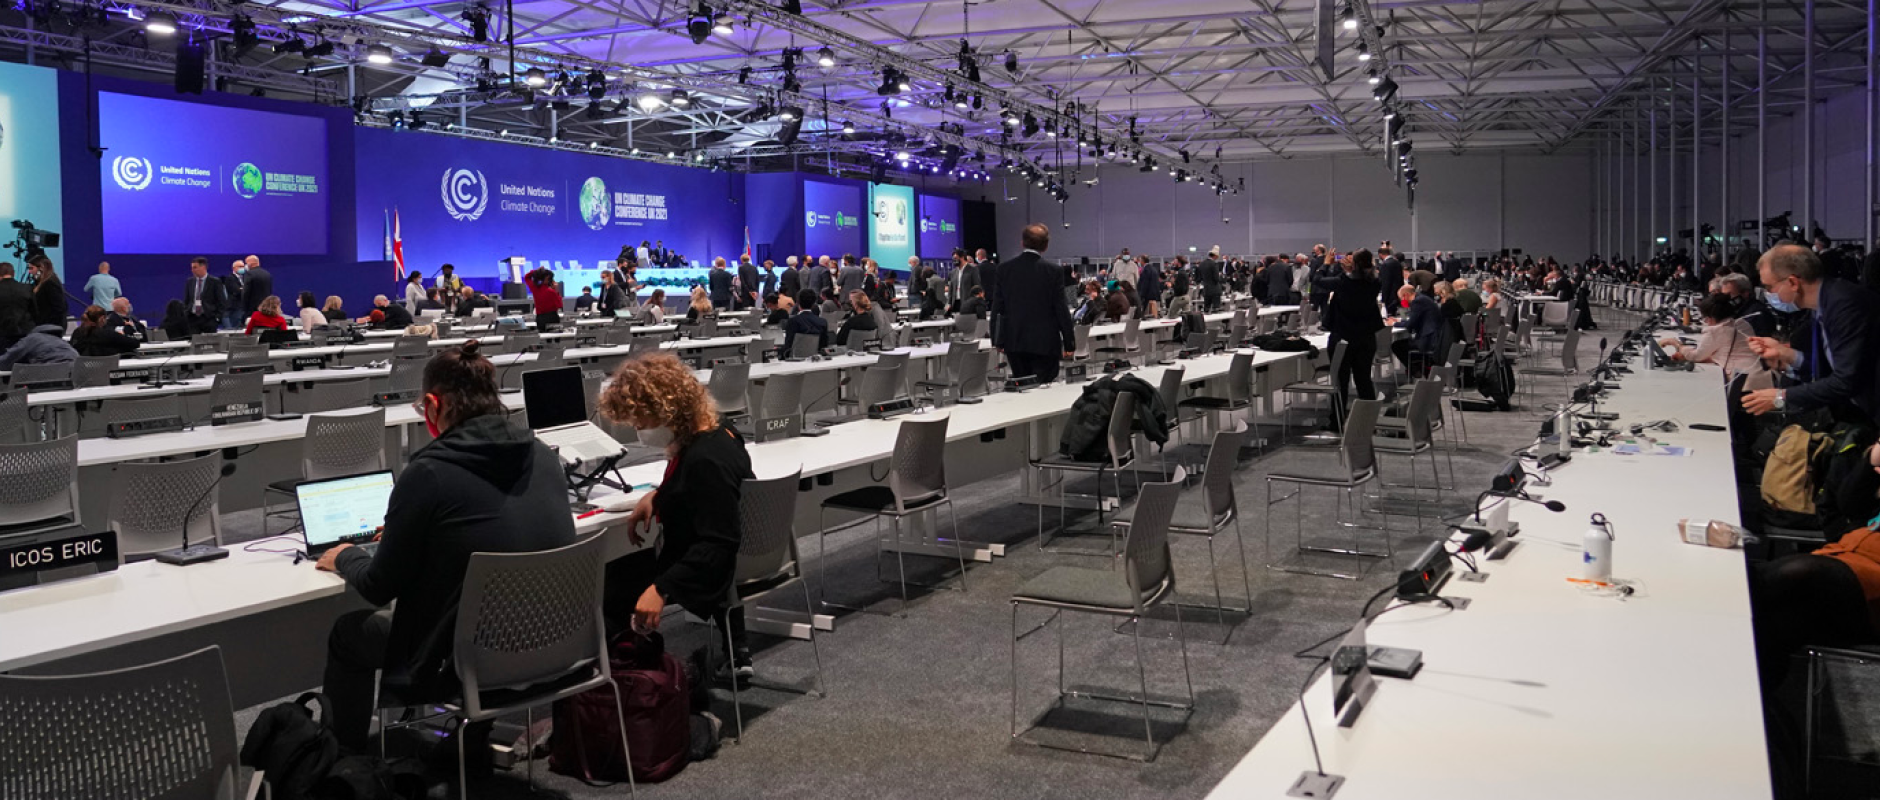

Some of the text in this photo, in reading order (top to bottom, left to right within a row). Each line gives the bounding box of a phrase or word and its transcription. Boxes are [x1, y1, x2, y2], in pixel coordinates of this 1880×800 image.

[160, 166, 211, 176] United Nations
[161, 176, 211, 188] Climate Change
[500, 184, 555, 198] United Nations
[622, 193, 645, 206] CLIMATE
[645, 194, 665, 208] CHANGE
[501, 201, 555, 215] Climate Change
[614, 205, 647, 219] CONFERENCE
[766, 418, 790, 430] ICRAF
[10, 539, 103, 568] ICOS ERIC
